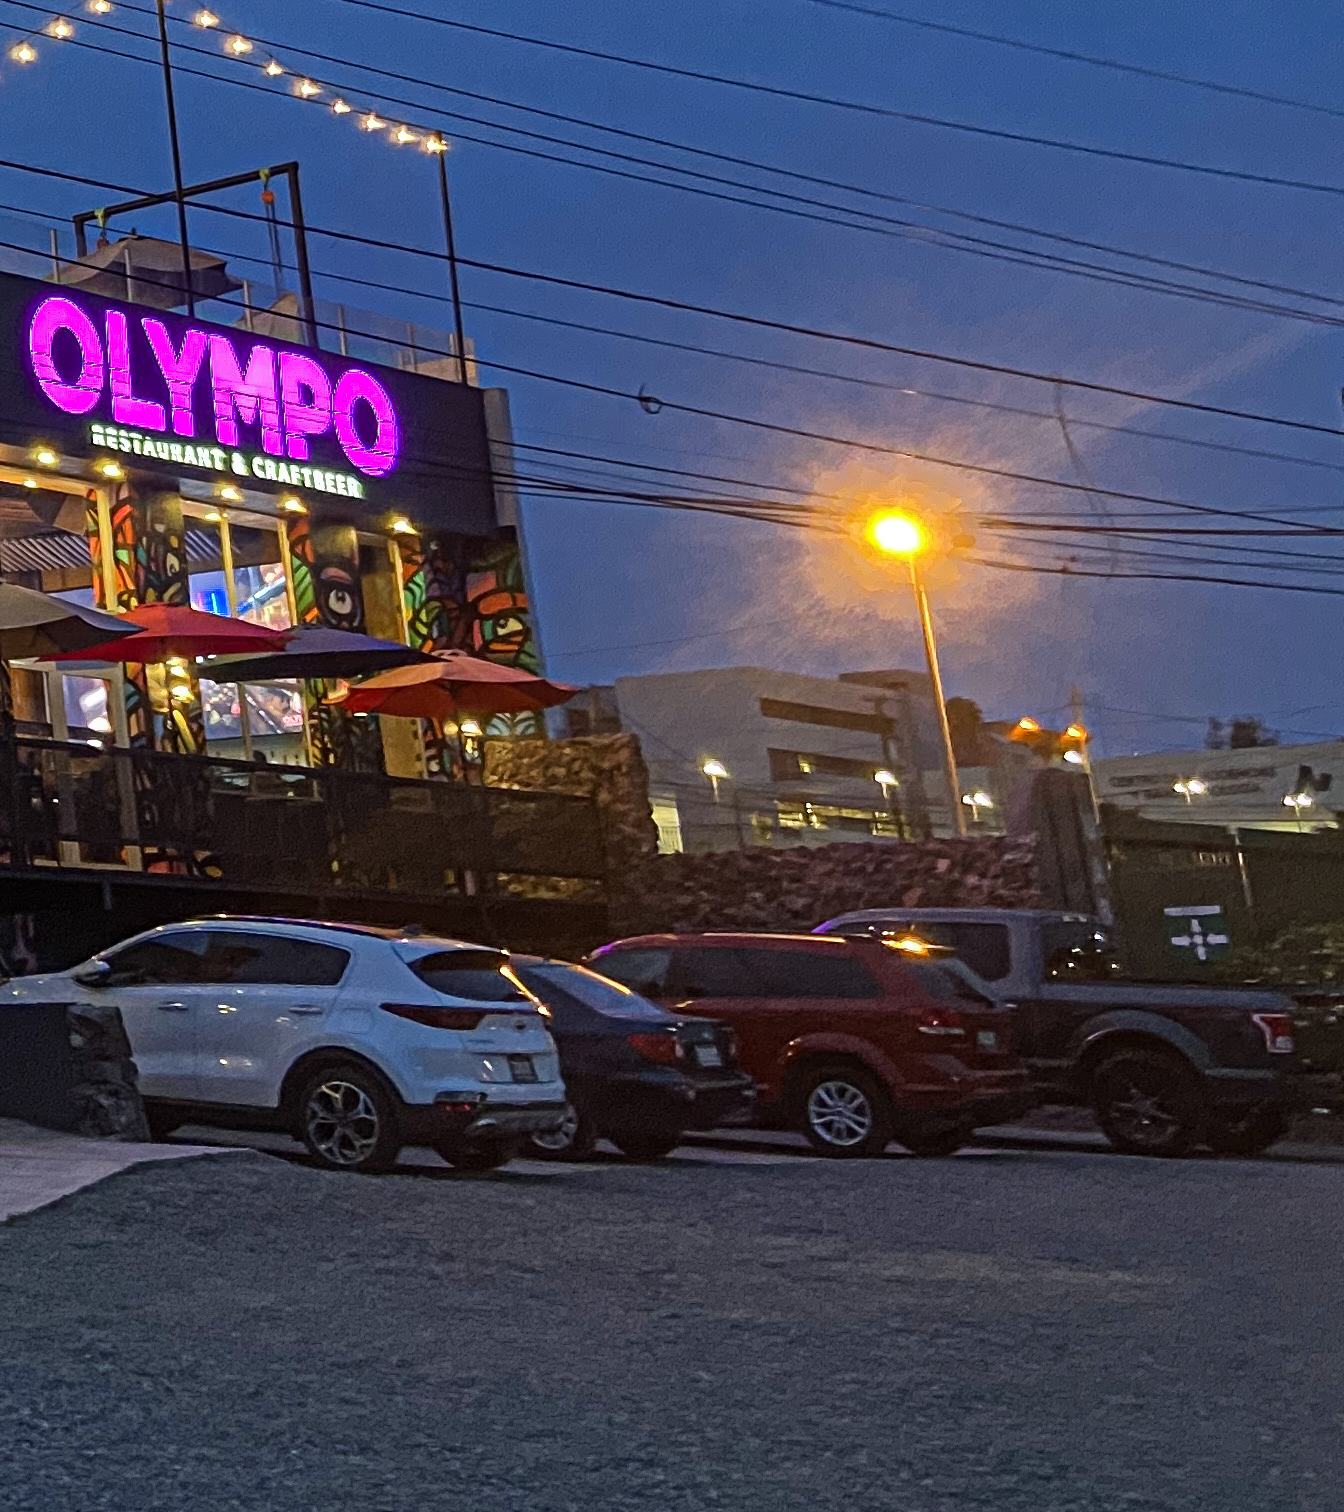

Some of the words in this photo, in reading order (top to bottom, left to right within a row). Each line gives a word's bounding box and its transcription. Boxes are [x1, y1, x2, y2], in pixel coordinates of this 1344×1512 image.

[30, 297, 398, 476] OLYMPO
[91, 424, 227, 471] RESTAURANT
[230, 450, 250, 476] &
[252, 455, 364, 499] CRAFTBEER
